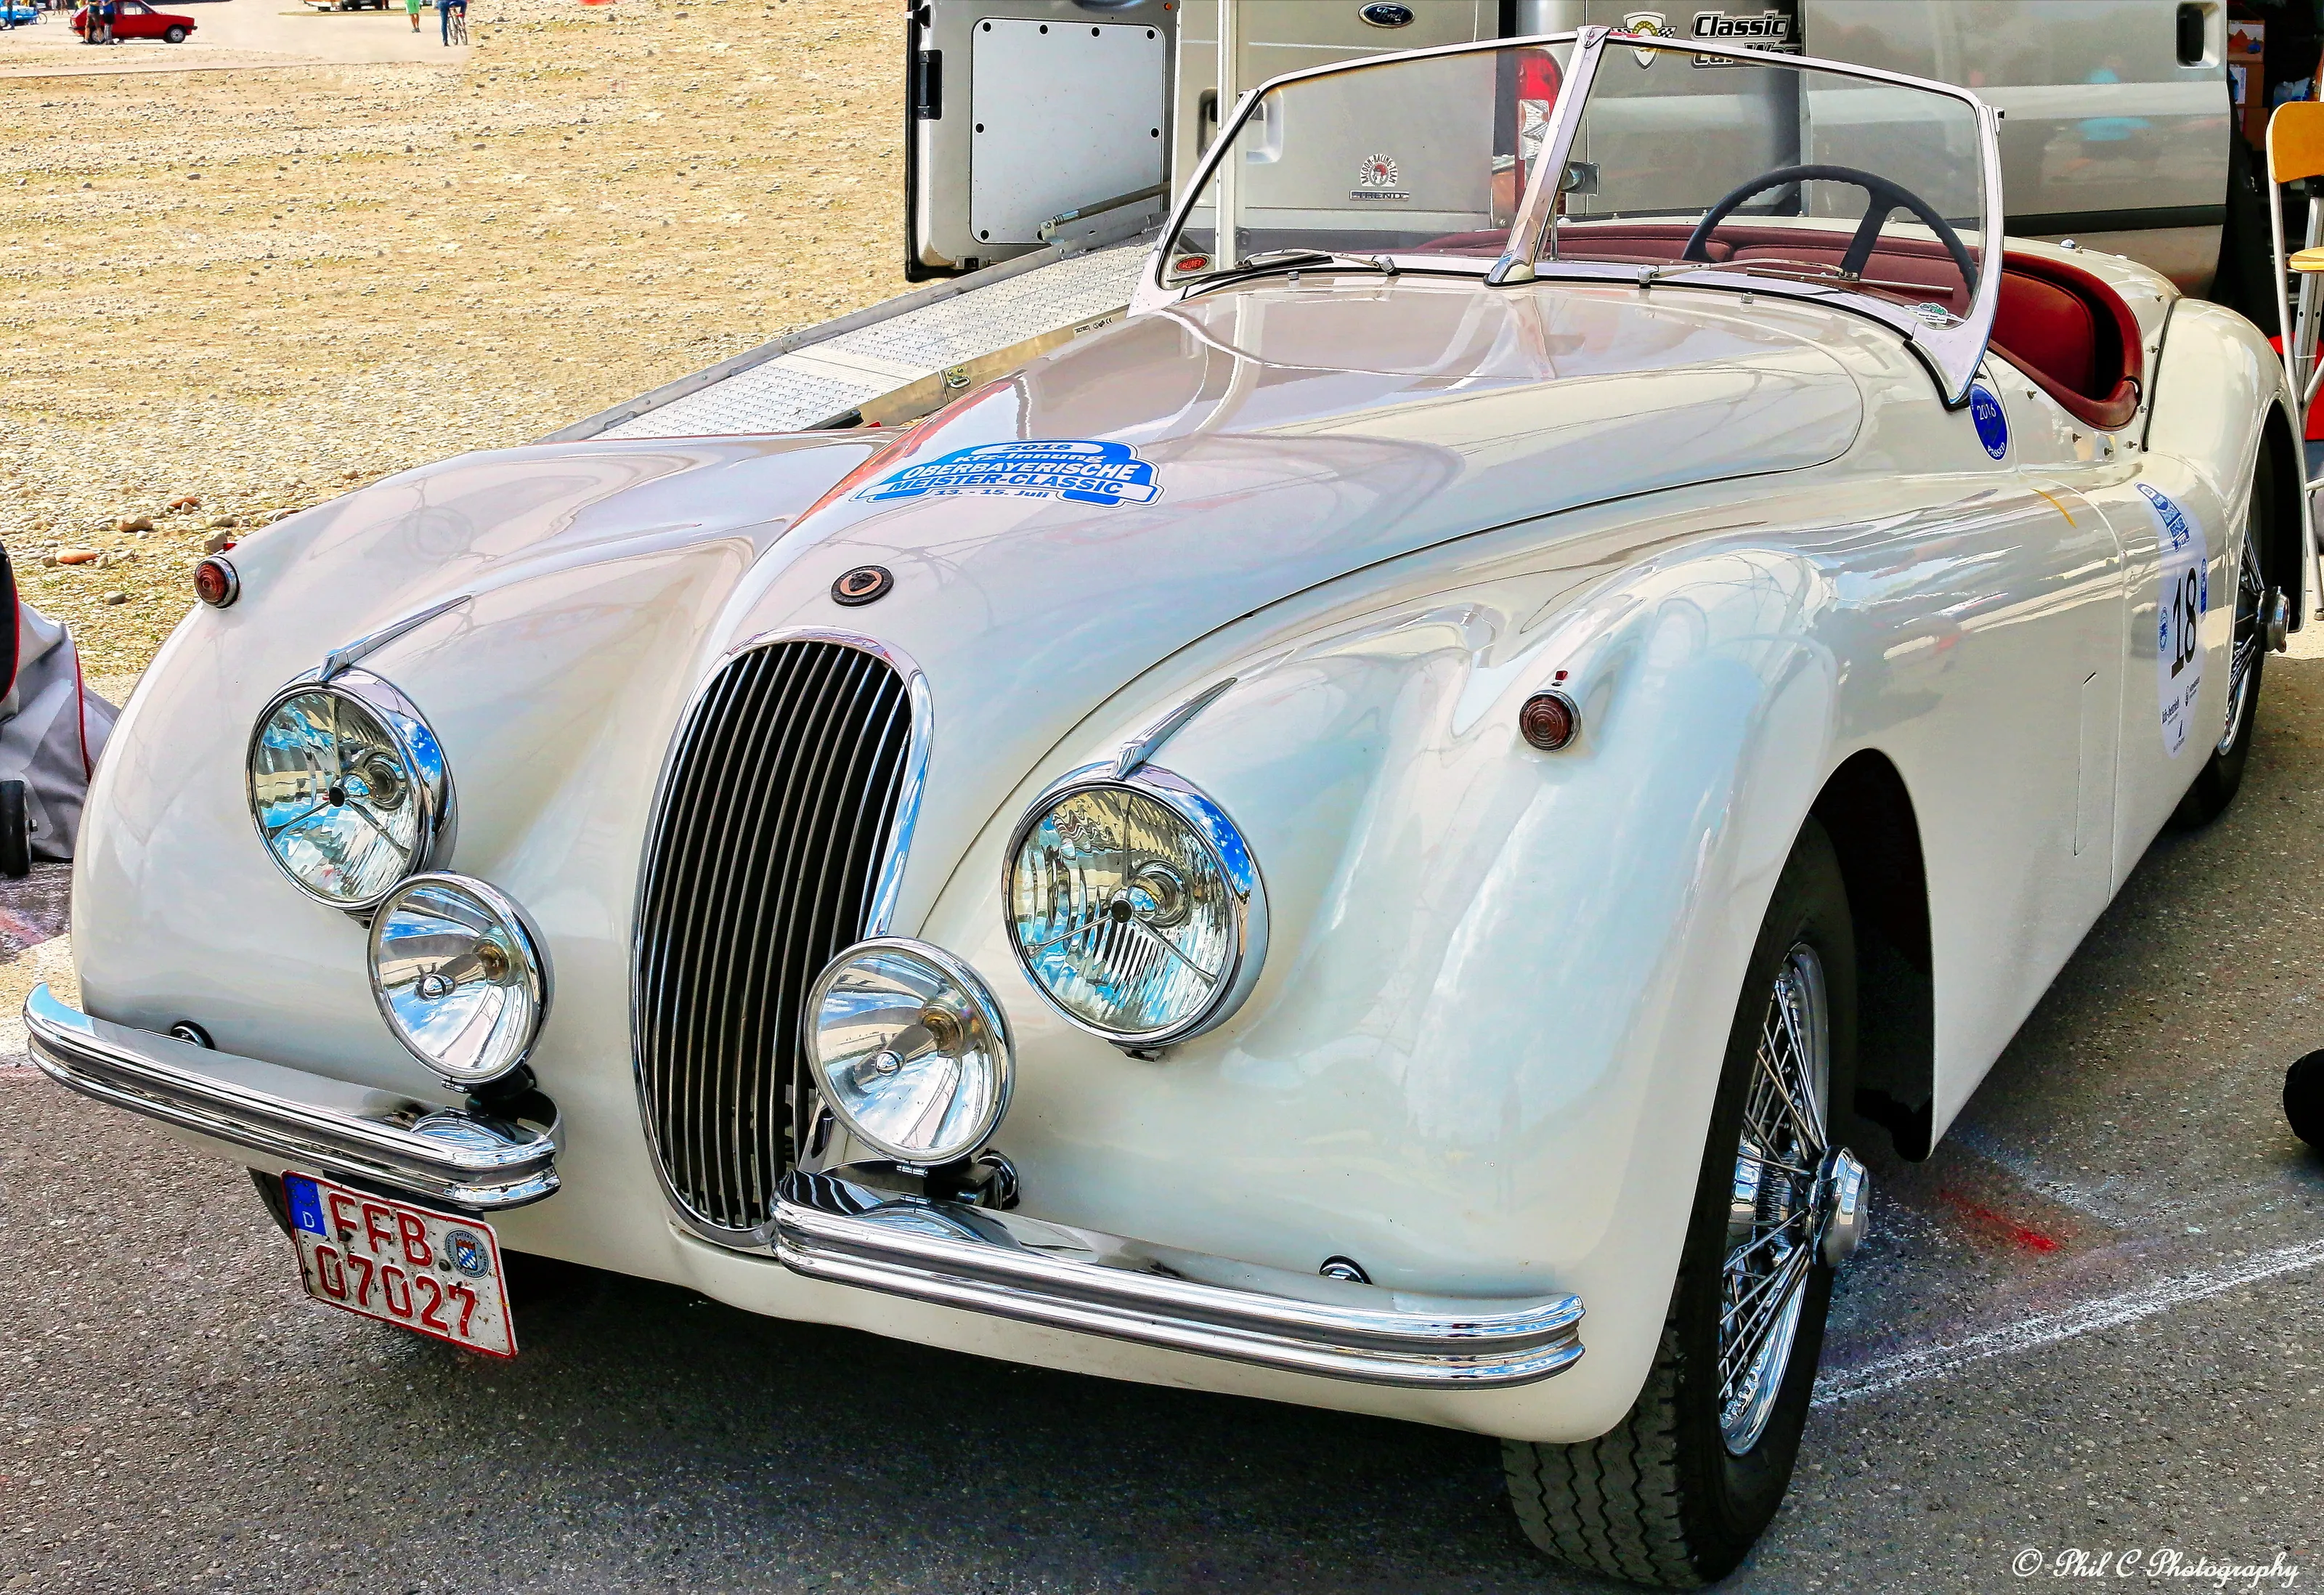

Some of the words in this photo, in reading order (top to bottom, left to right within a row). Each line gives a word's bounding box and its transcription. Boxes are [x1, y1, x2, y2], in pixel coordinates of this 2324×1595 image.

[1373, 6, 1404, 22] Ford
[1694, 15, 1787, 37] Classic
[1977, 403, 1996, 421] 2016
[1003, 443, 1073, 452] 2018
[1987, 442, 2006, 458] PASSED
[952, 452, 1108, 464] Kfz-Innung
[902, 461, 1141, 482] OBERBAYERISCHE
[890, 473, 1124, 495] MEISTER-CLASSIC
[2171, 567, 2197, 680] 18
[304, 1212, 314, 1229] D
[328, 1191, 434, 1267] FFB
[314, 1244, 476, 1337] 07027
